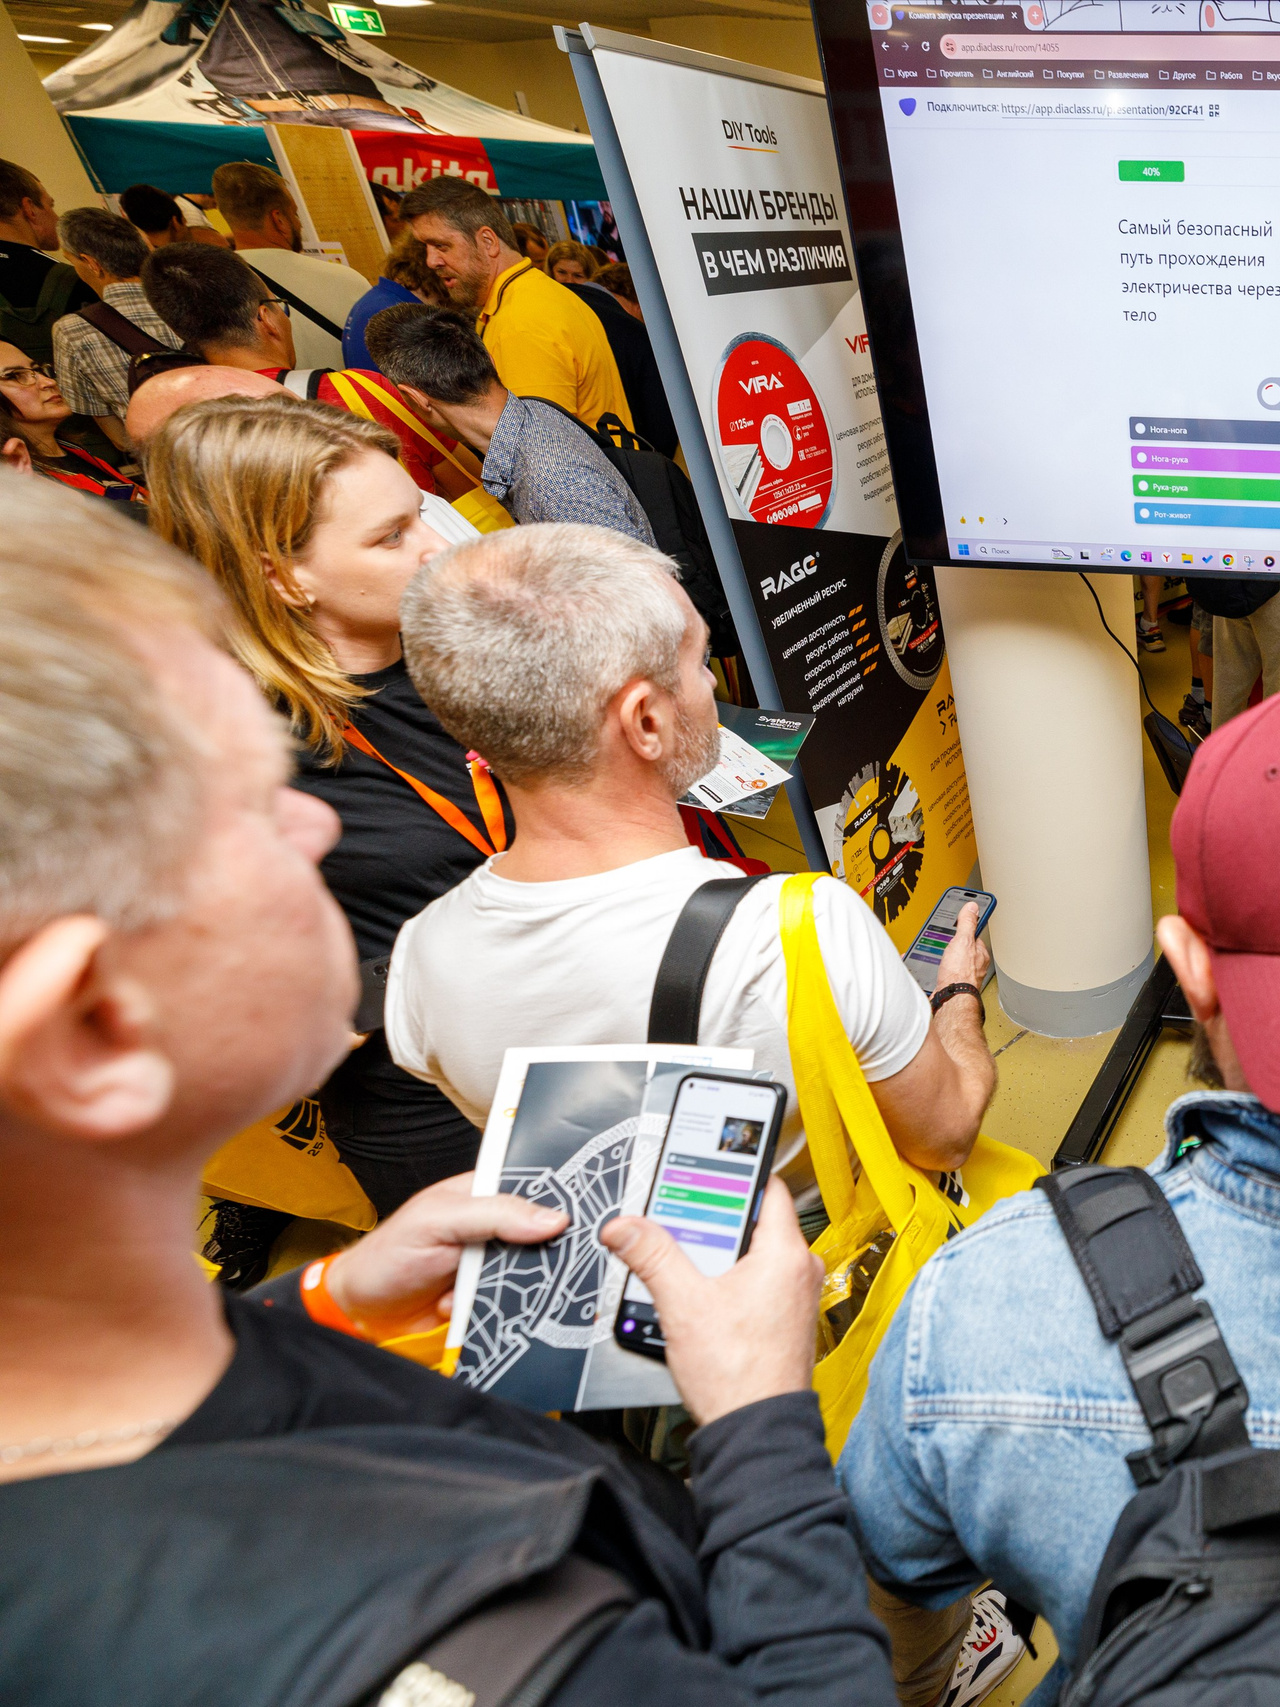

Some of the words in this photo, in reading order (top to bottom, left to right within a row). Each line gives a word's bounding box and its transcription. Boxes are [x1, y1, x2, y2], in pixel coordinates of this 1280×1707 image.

[908, 11, 935, 20] Комната
[936, 12, 961, 21] запуска
[962, 12, 1004, 20] презентации
[961, 43, 1060, 53] app.diaclass.ru/room/14055
[897, 70, 918, 79] Курсы
[940, 70, 974, 79] Прочитать
[996, 69, 1034, 79] Английский
[1056, 70, 1085, 80] Покупки
[1108, 70, 1149, 80] Развлечения
[1172, 71, 1196, 81] Другое
[1220, 71, 1243, 81] Работа
[926, 101, 1000, 113] Подключиться:
[1001, 103, 1204, 117] https://app.diaclass.ru/pesentation/92CF41
[721, 119, 744, 141] DIY
[745, 123, 778, 146] Tools
[366, 158, 501, 196] akita
[1142, 167, 1161, 177] 40%
[678, 186, 759, 221] НАШИ
[758, 189, 839, 226] БРЕНДЫ
[1117, 219, 1172, 237] Самый
[1176, 219, 1274, 238] безопасный
[701, 251, 719, 279] В
[720, 248, 766, 277] ЧЕМ
[766, 245, 848, 275] РАЗЛИЧИЯ
[1119, 252, 1154, 267] путь
[1158, 252, 1265, 269] прохождения
[1121, 281, 1233, 297] электричества
[1123, 309, 1158, 323] тело
[738, 373, 785, 396] VIRA
[1149, 424, 1188, 435] Нога-нога
[1151, 454, 1189, 466] Нога-рука
[1152, 482, 1189, 494] Рука-рука
[1153, 510, 1192, 520] Рот-живот
[991, 547, 1011, 555] Поиск
[771, 592, 821, 630] УВЕЛИЧЕННЫЙ
[821, 578, 848, 600] РЕСУРС
[782, 635, 809, 660] ценовая
[808, 614, 846, 643] доступность
[806, 643, 828, 664] ресурс
[827, 630, 850, 653] работы
[804, 658, 832, 682] скорость
[831, 644, 854, 667] работы
[807, 673, 836, 699] удобство
[835, 659, 858, 680] работы
[812, 673, 862, 713] выдерживаемые
[837, 683, 865, 709] нагрузки
[307, 1142, 324, 1157] 25
